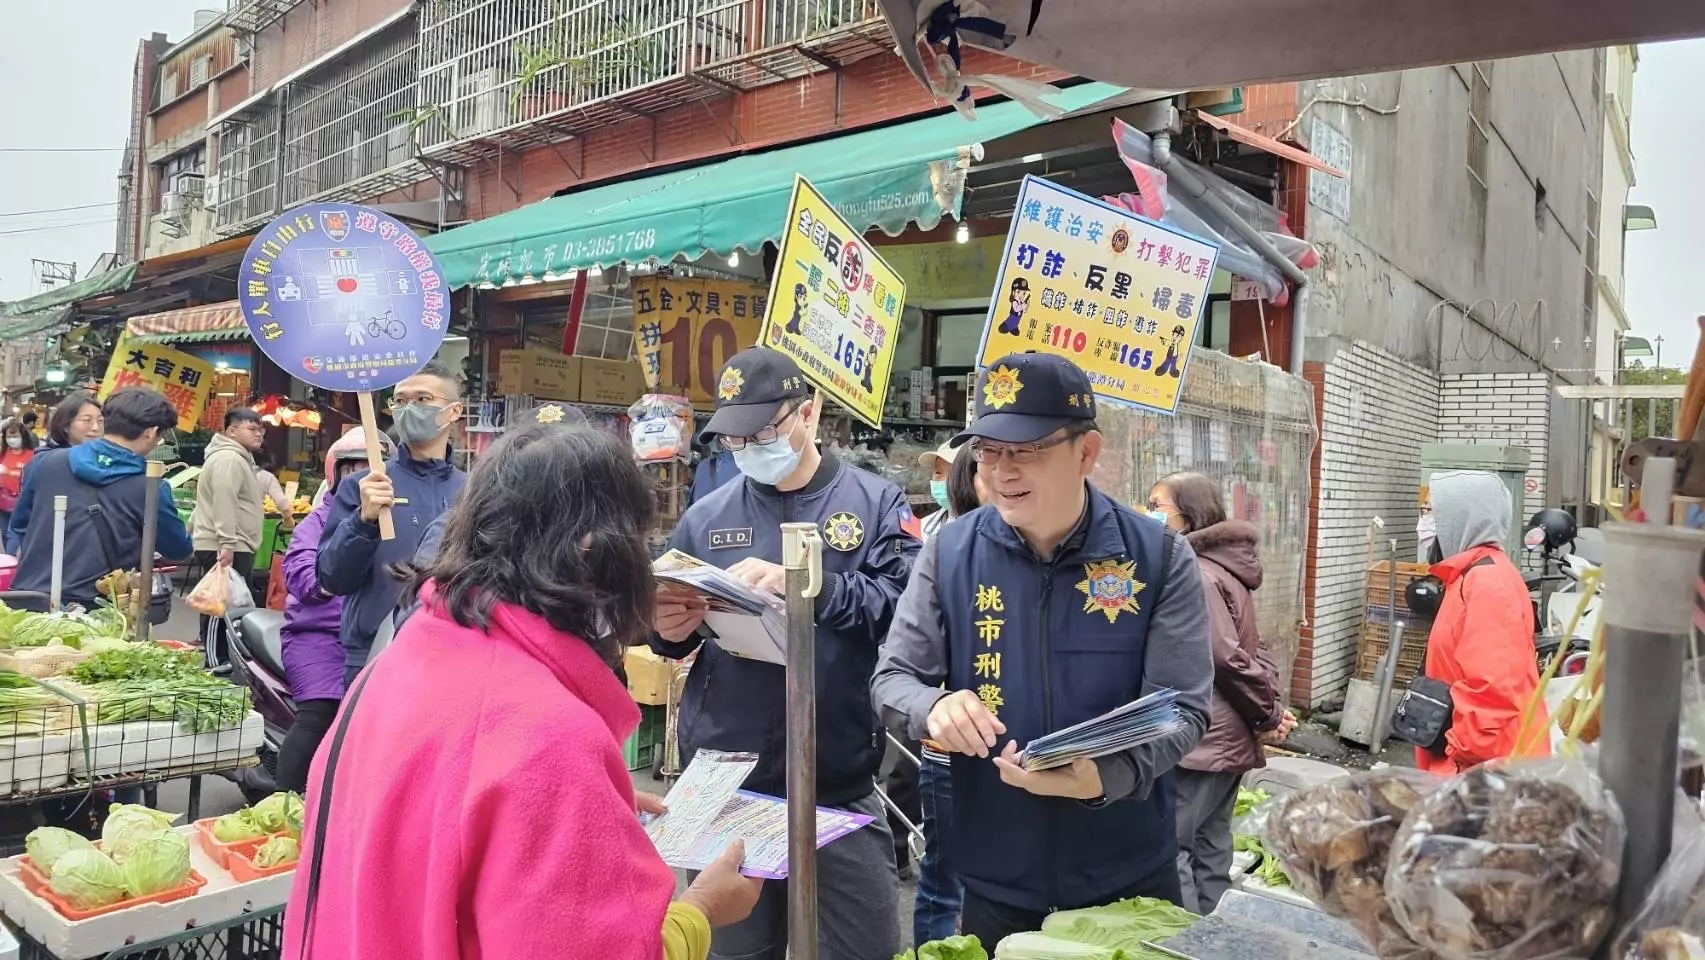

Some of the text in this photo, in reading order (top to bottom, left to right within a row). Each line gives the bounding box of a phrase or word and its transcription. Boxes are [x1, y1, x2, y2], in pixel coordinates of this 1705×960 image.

[563, 228, 656, 261] 03-3851768
[1022, 198, 1210, 281] 維護治安 打擊犯罪
[126, 350, 201, 388] 大吉利
[660, 317, 737, 399] 10
[834, 333, 865, 377] 165
[1051, 324, 1087, 353] 110
[1119, 343, 1153, 370] 165
[973, 583, 1006, 716] 桃市刑警
